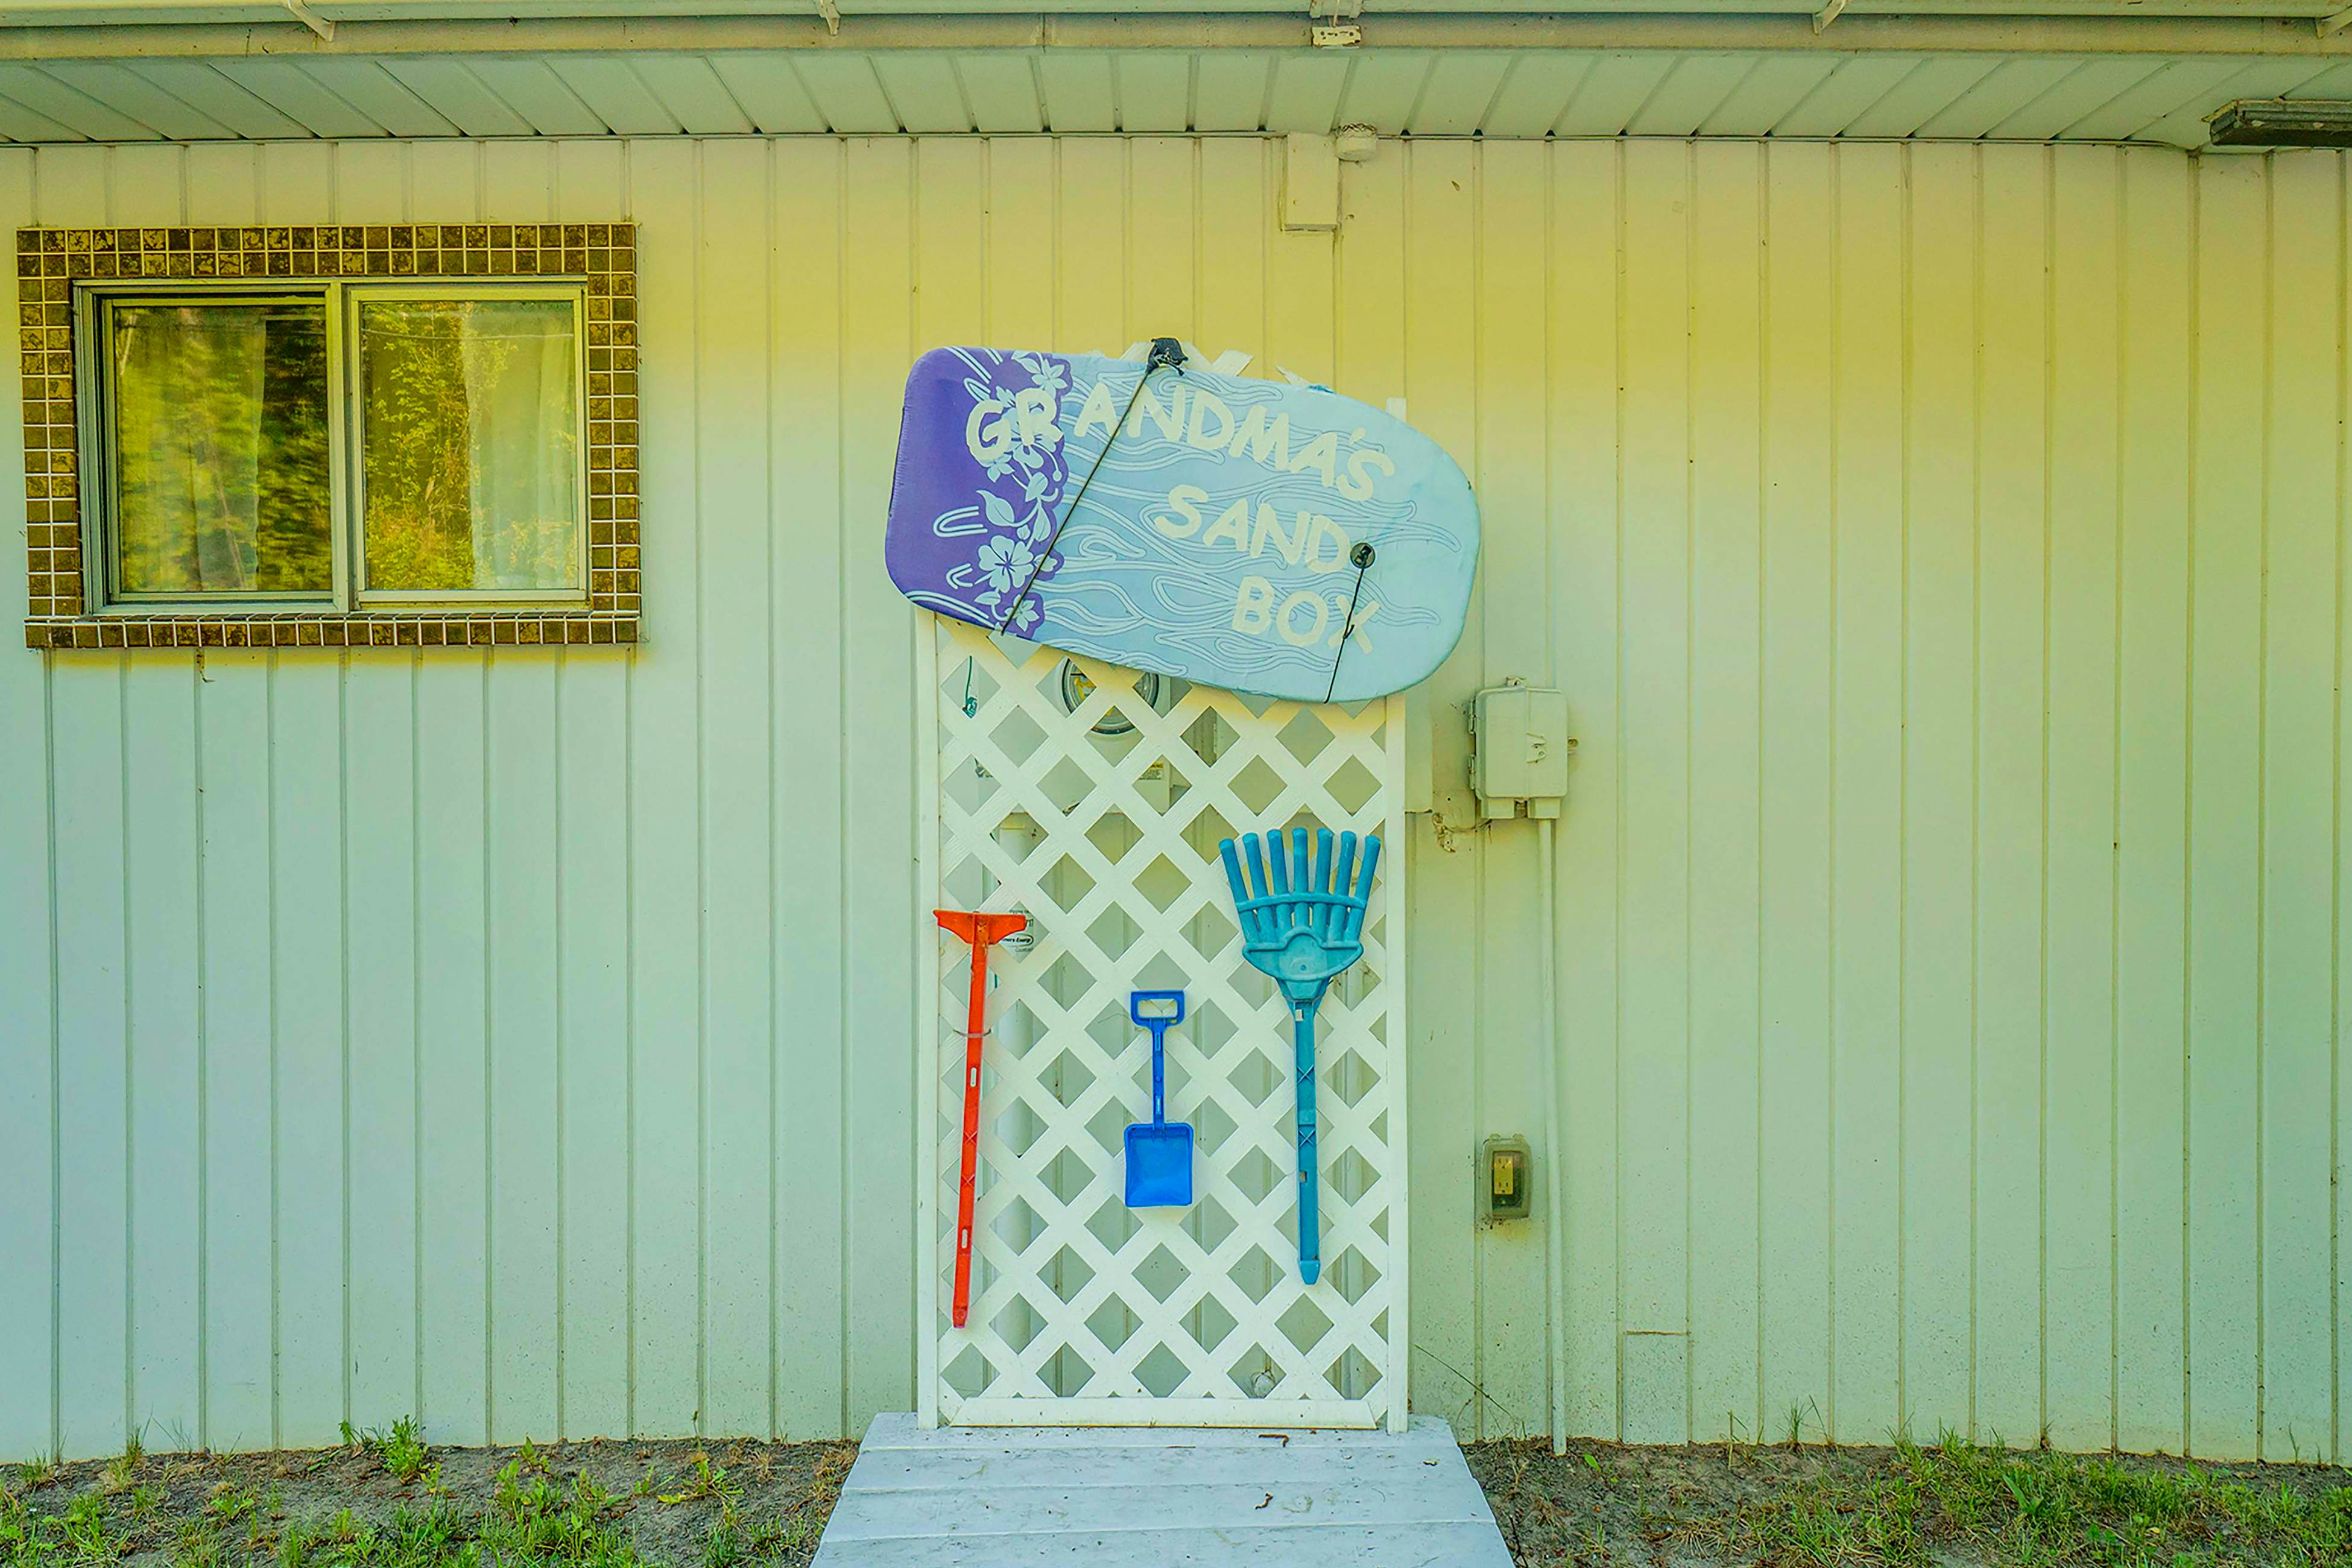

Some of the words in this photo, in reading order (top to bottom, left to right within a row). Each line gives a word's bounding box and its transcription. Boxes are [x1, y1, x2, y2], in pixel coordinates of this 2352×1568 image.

[967, 386, 1394, 501] GRANDMA'S
[1155, 484, 1351, 574] SAND
[1233, 576, 1379, 653] BOX
